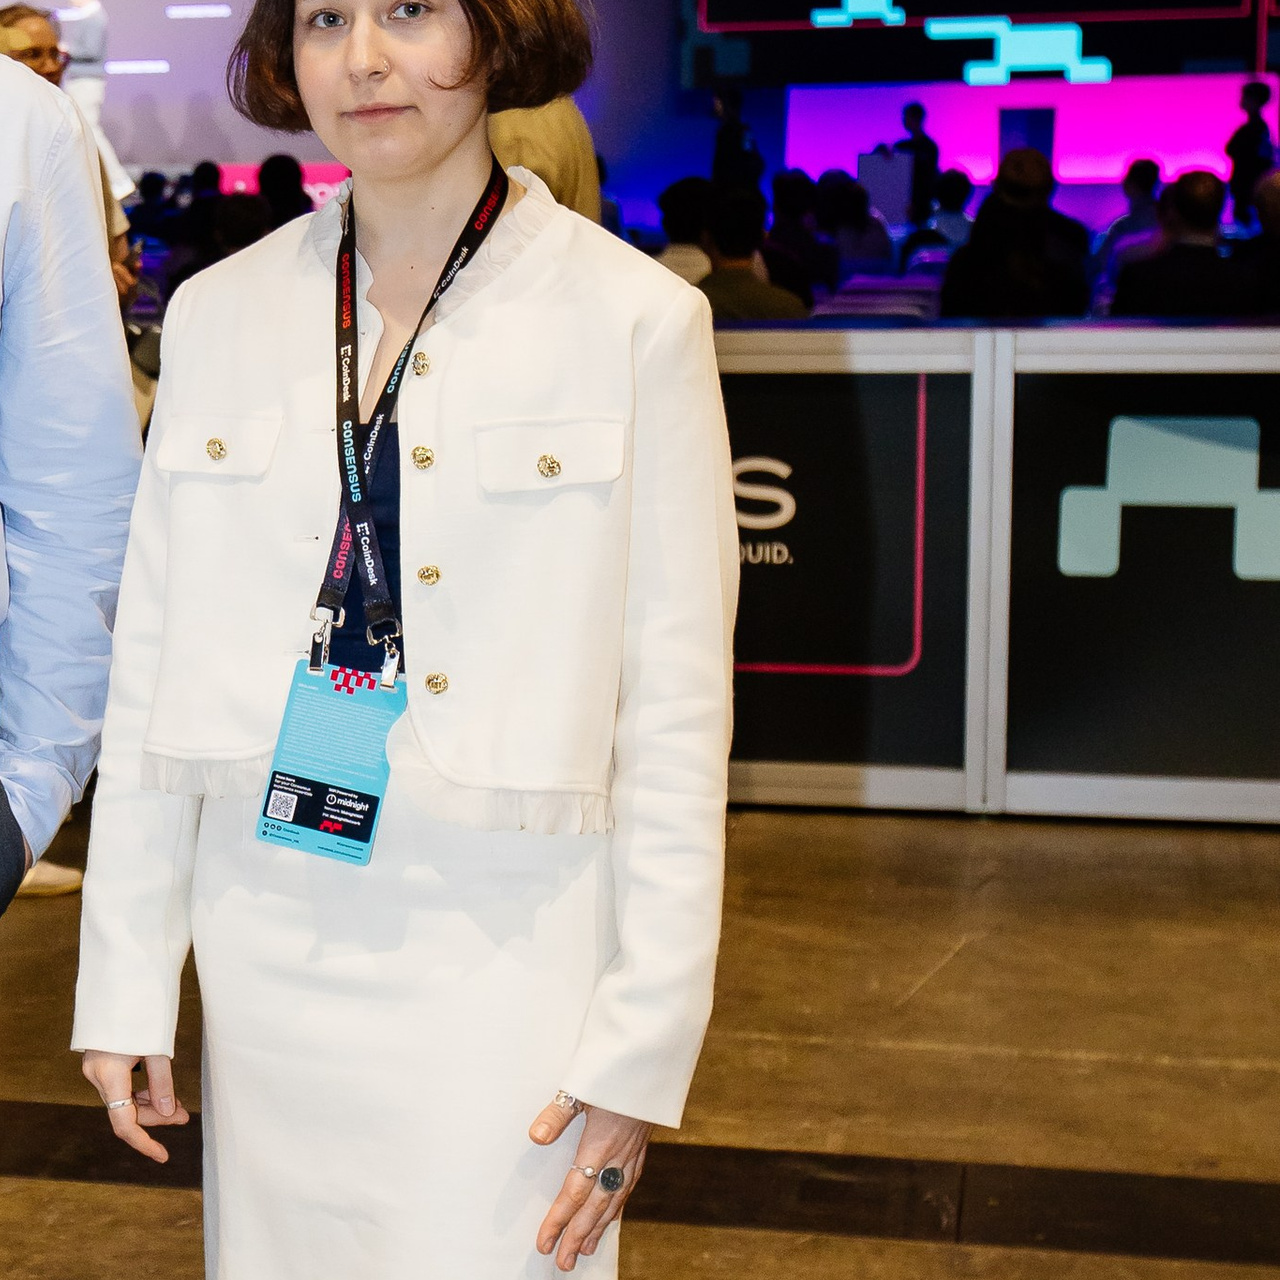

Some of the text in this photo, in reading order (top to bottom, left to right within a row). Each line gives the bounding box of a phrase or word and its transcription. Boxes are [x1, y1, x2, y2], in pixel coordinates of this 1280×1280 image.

[441, 245, 469, 288] CoinDesk
[342, 357, 351, 403] CoinDesk
[363, 414, 385, 461] CoinDesk
[342, 420, 362, 503] CONSENSUS
[360, 536, 377, 587] CoinDesk
[739, 540, 794, 565] UID.
[337, 797, 369, 812] midnight
